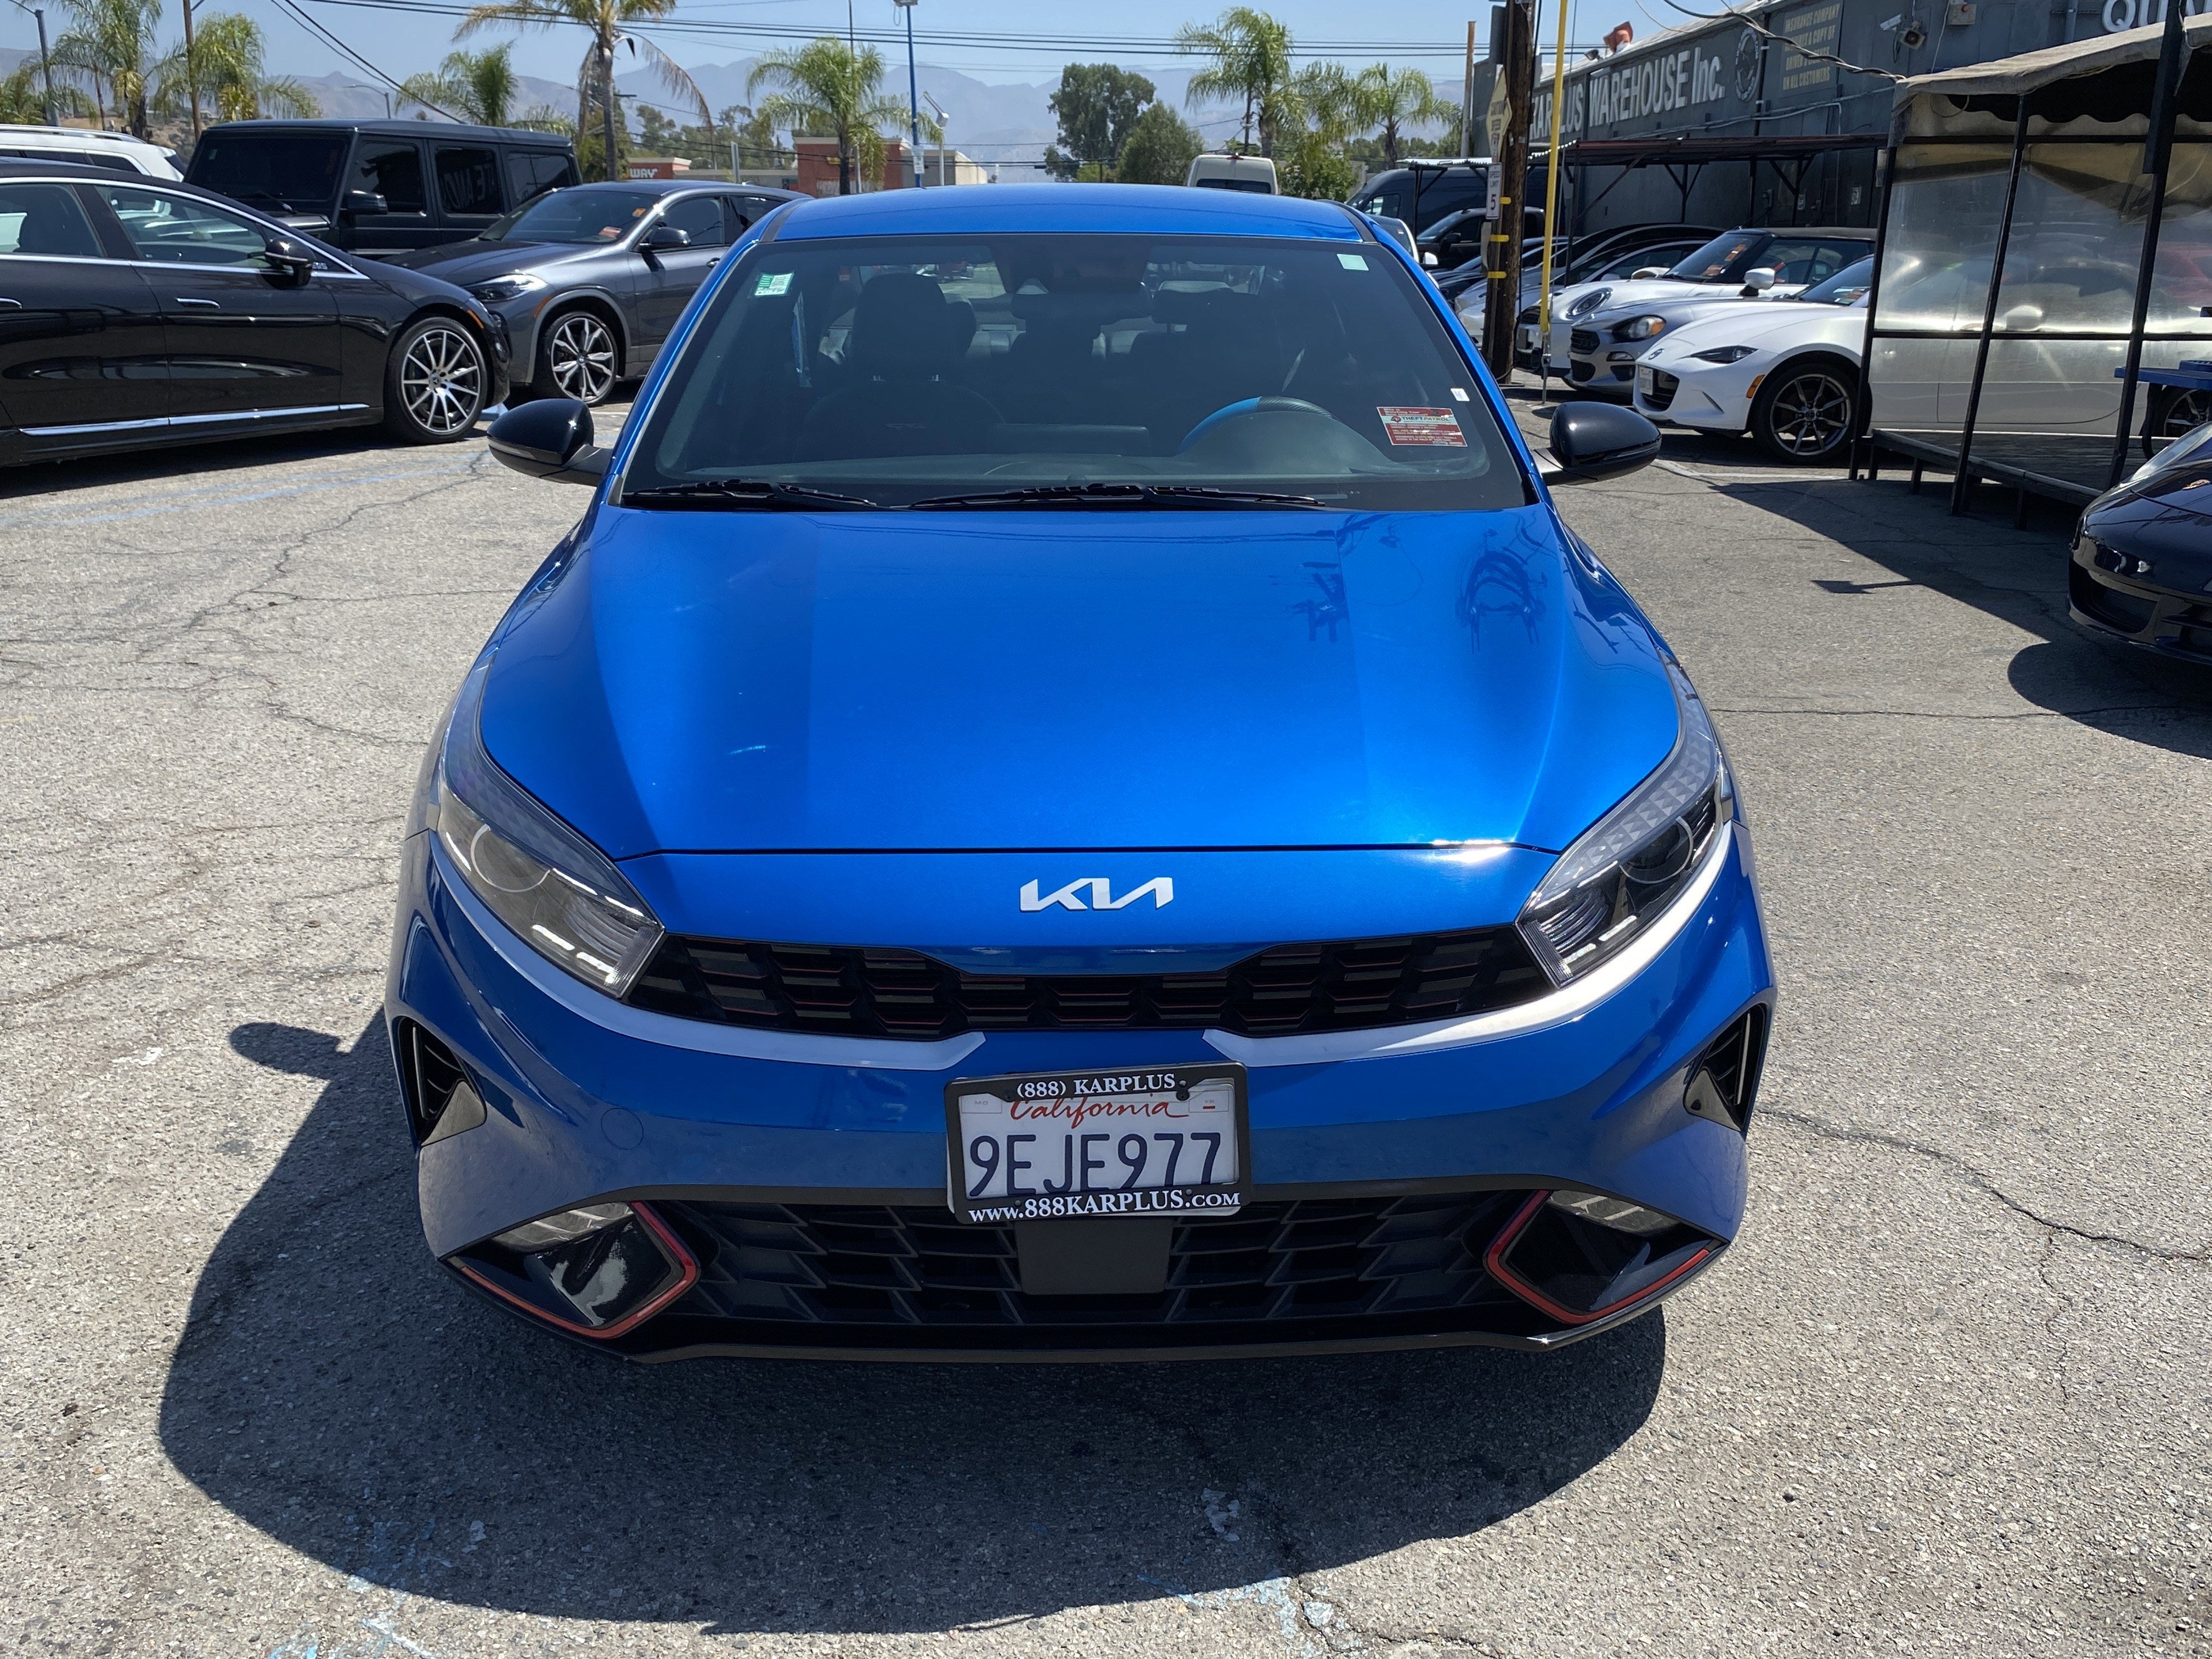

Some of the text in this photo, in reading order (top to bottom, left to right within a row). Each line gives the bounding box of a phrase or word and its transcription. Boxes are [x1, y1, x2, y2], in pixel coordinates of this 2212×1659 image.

[1589, 50, 1691, 127] WAREHOUSE
[1691, 47, 1725, 104] Inc.
[1491, 194, 1496, 210] 5
[1017, 1074, 1175, 1098] (888) KARPLUS
[1011, 1093, 1189, 1129] California
[969, 1132, 1221, 1197] 9EJE977
